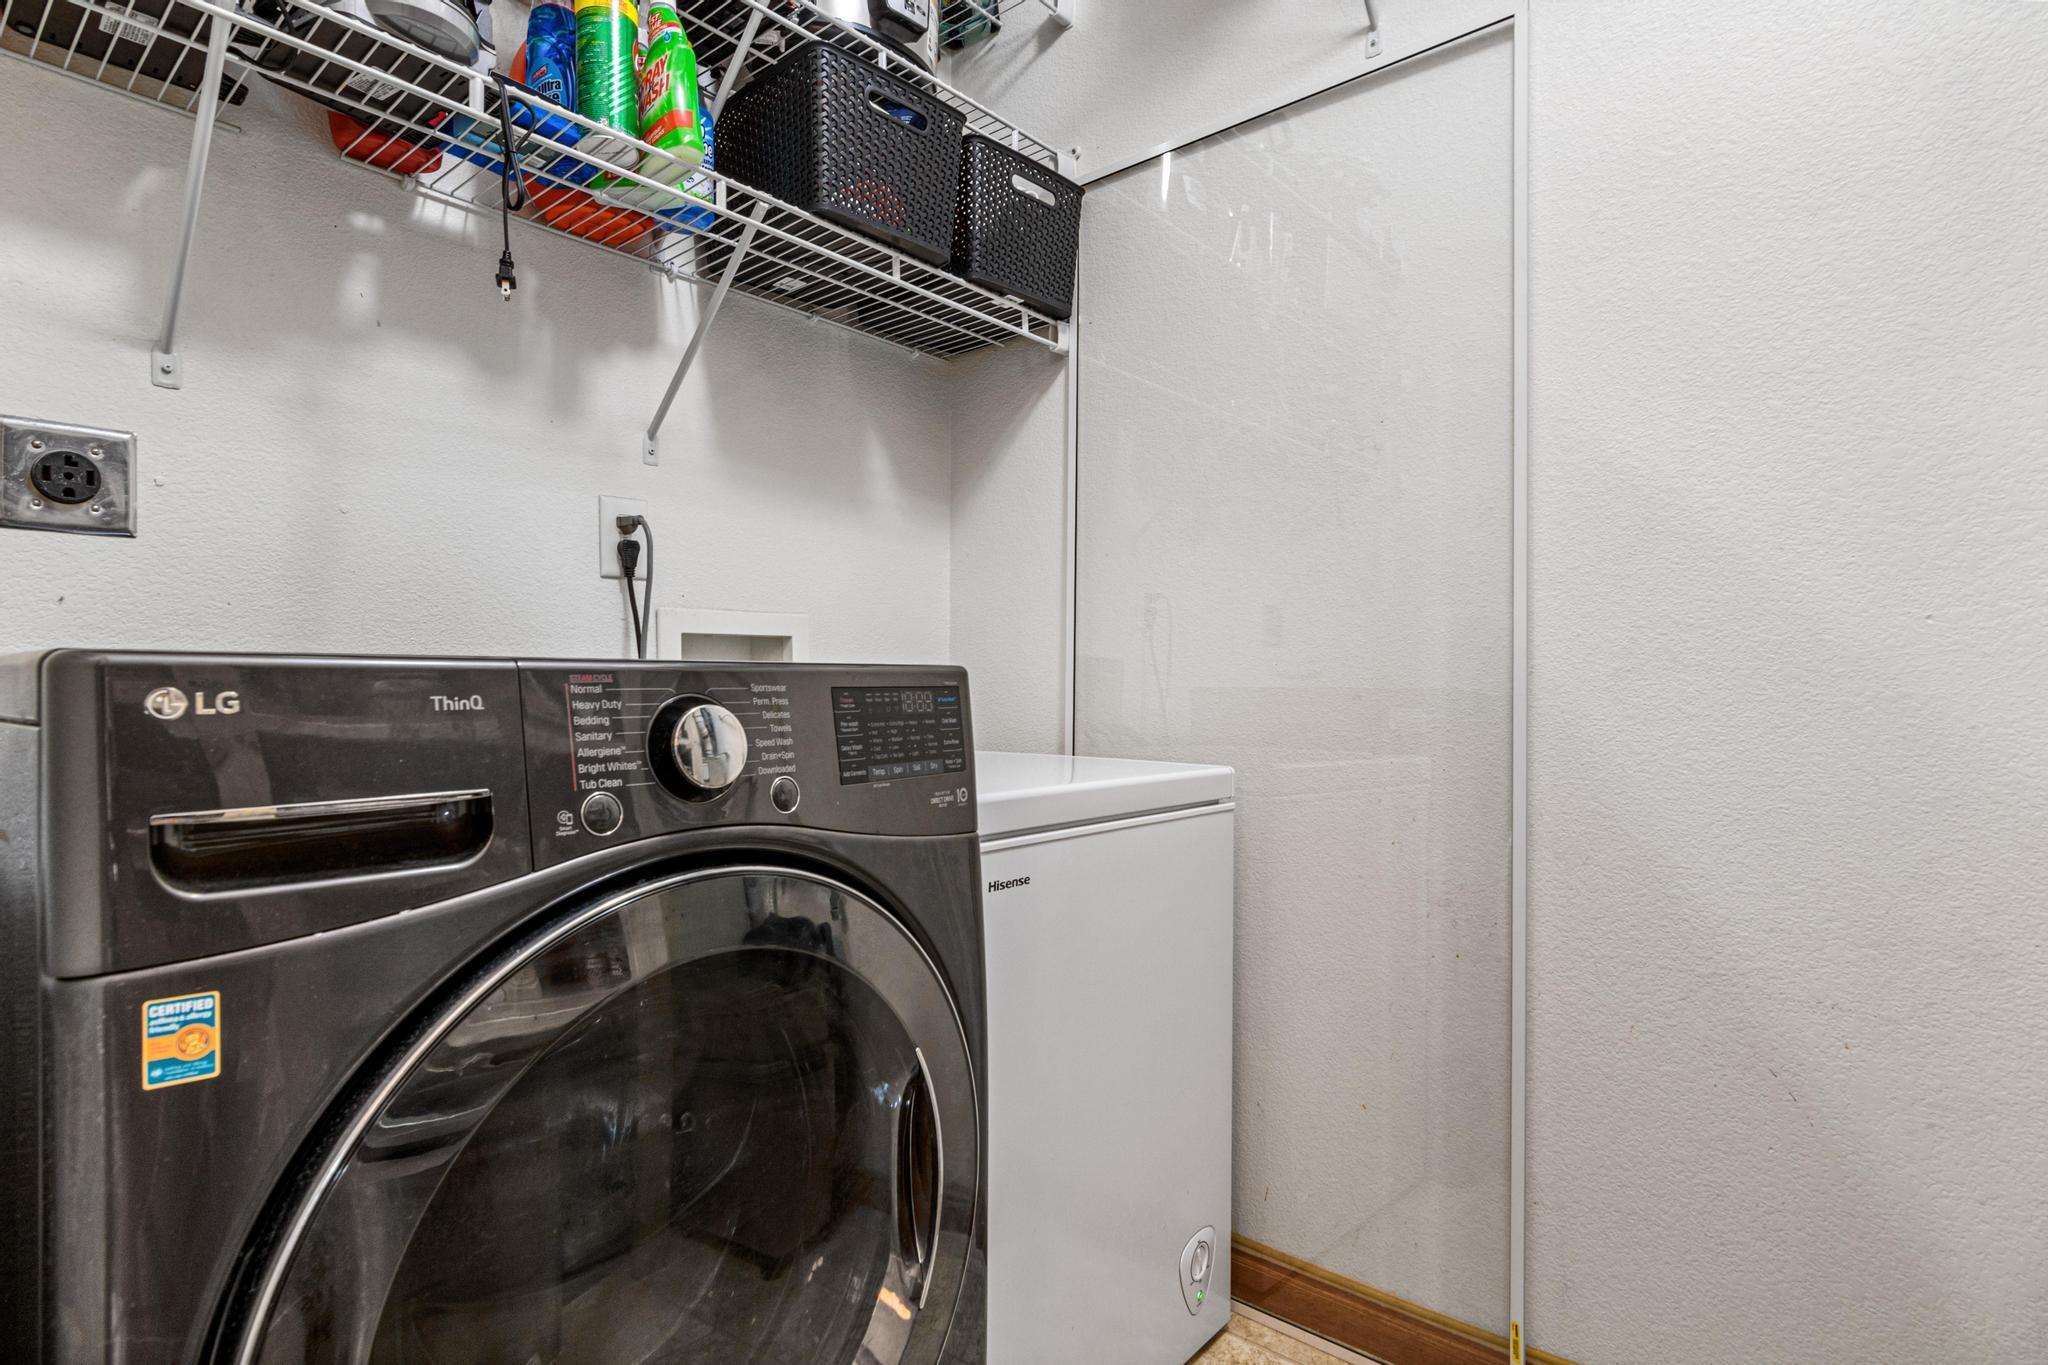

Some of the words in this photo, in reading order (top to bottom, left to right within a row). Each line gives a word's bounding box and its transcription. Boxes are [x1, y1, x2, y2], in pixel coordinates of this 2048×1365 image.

[570, 684, 603, 694] Normal
[750, 683, 787, 693] Sportswear
[195, 691, 240, 715] LG
[430, 695, 485, 711] ThinQ
[571, 700, 600, 711] Heavy
[601, 699, 622, 710] Duty
[771, 697, 789, 705] Press
[573, 715, 610, 727] Bedding
[762, 711, 790, 719] Delicates
[770, 724, 792, 732] Towels
[575, 731, 612, 742] Sanitary
[755, 738, 775, 748] Speed
[775, 737, 794, 746] Wash
[577, 763, 606, 775] Bright
[758, 764, 796, 775] Downloaded
[579, 780, 597, 790] Tub
[598, 778, 623, 788] Clean
[956, 787, 968, 803] 10
[988, 876, 1031, 893] Hisense
[148, 997, 214, 1019] CERTIFIED
